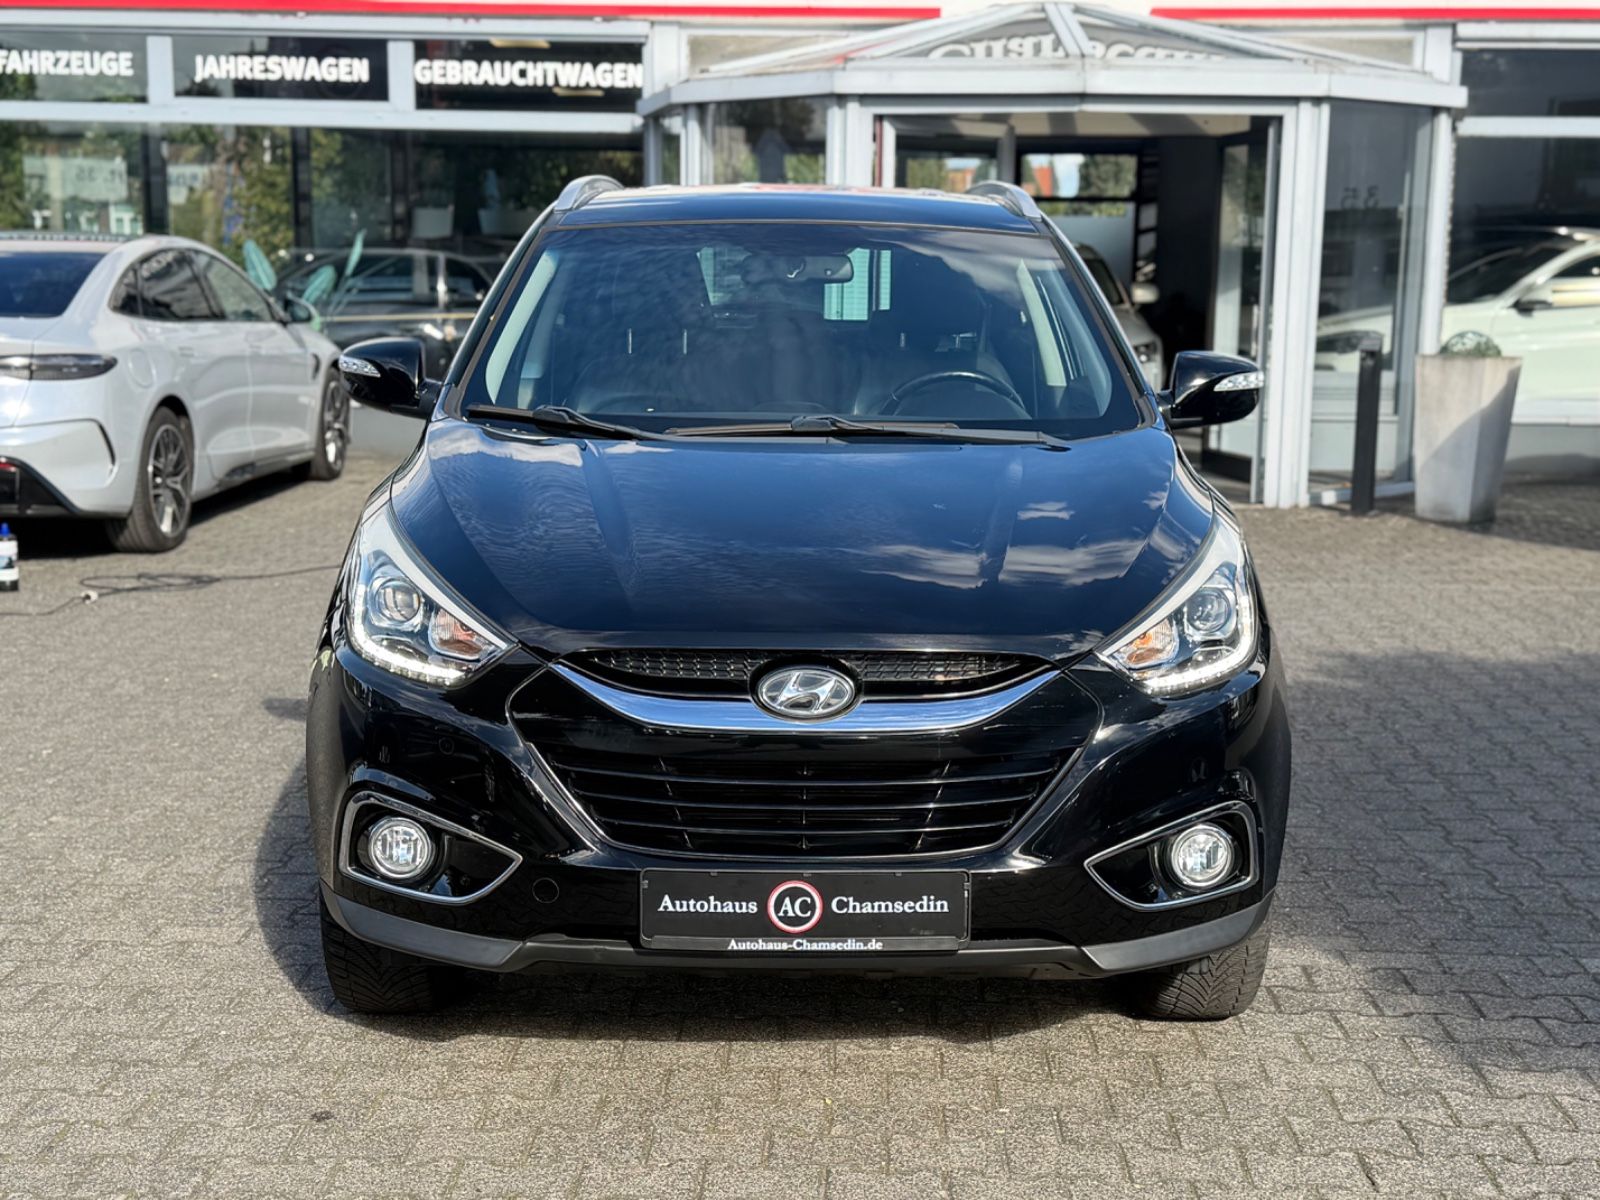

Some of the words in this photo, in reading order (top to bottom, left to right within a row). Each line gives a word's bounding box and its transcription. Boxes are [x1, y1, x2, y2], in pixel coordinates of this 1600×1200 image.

[0, 49, 134, 76] FAHRZEUGE
[194, 54, 370, 83] JAHRESWAGEN
[414, 59, 643, 88] GEBRAUCHTWAGEN
[657, 894, 758, 914] Autohaus
[777, 896, 812, 918] AC
[830, 894, 950, 914] Chamsedin
[727, 938, 884, 951] Autohaus-Chamsedin.de
